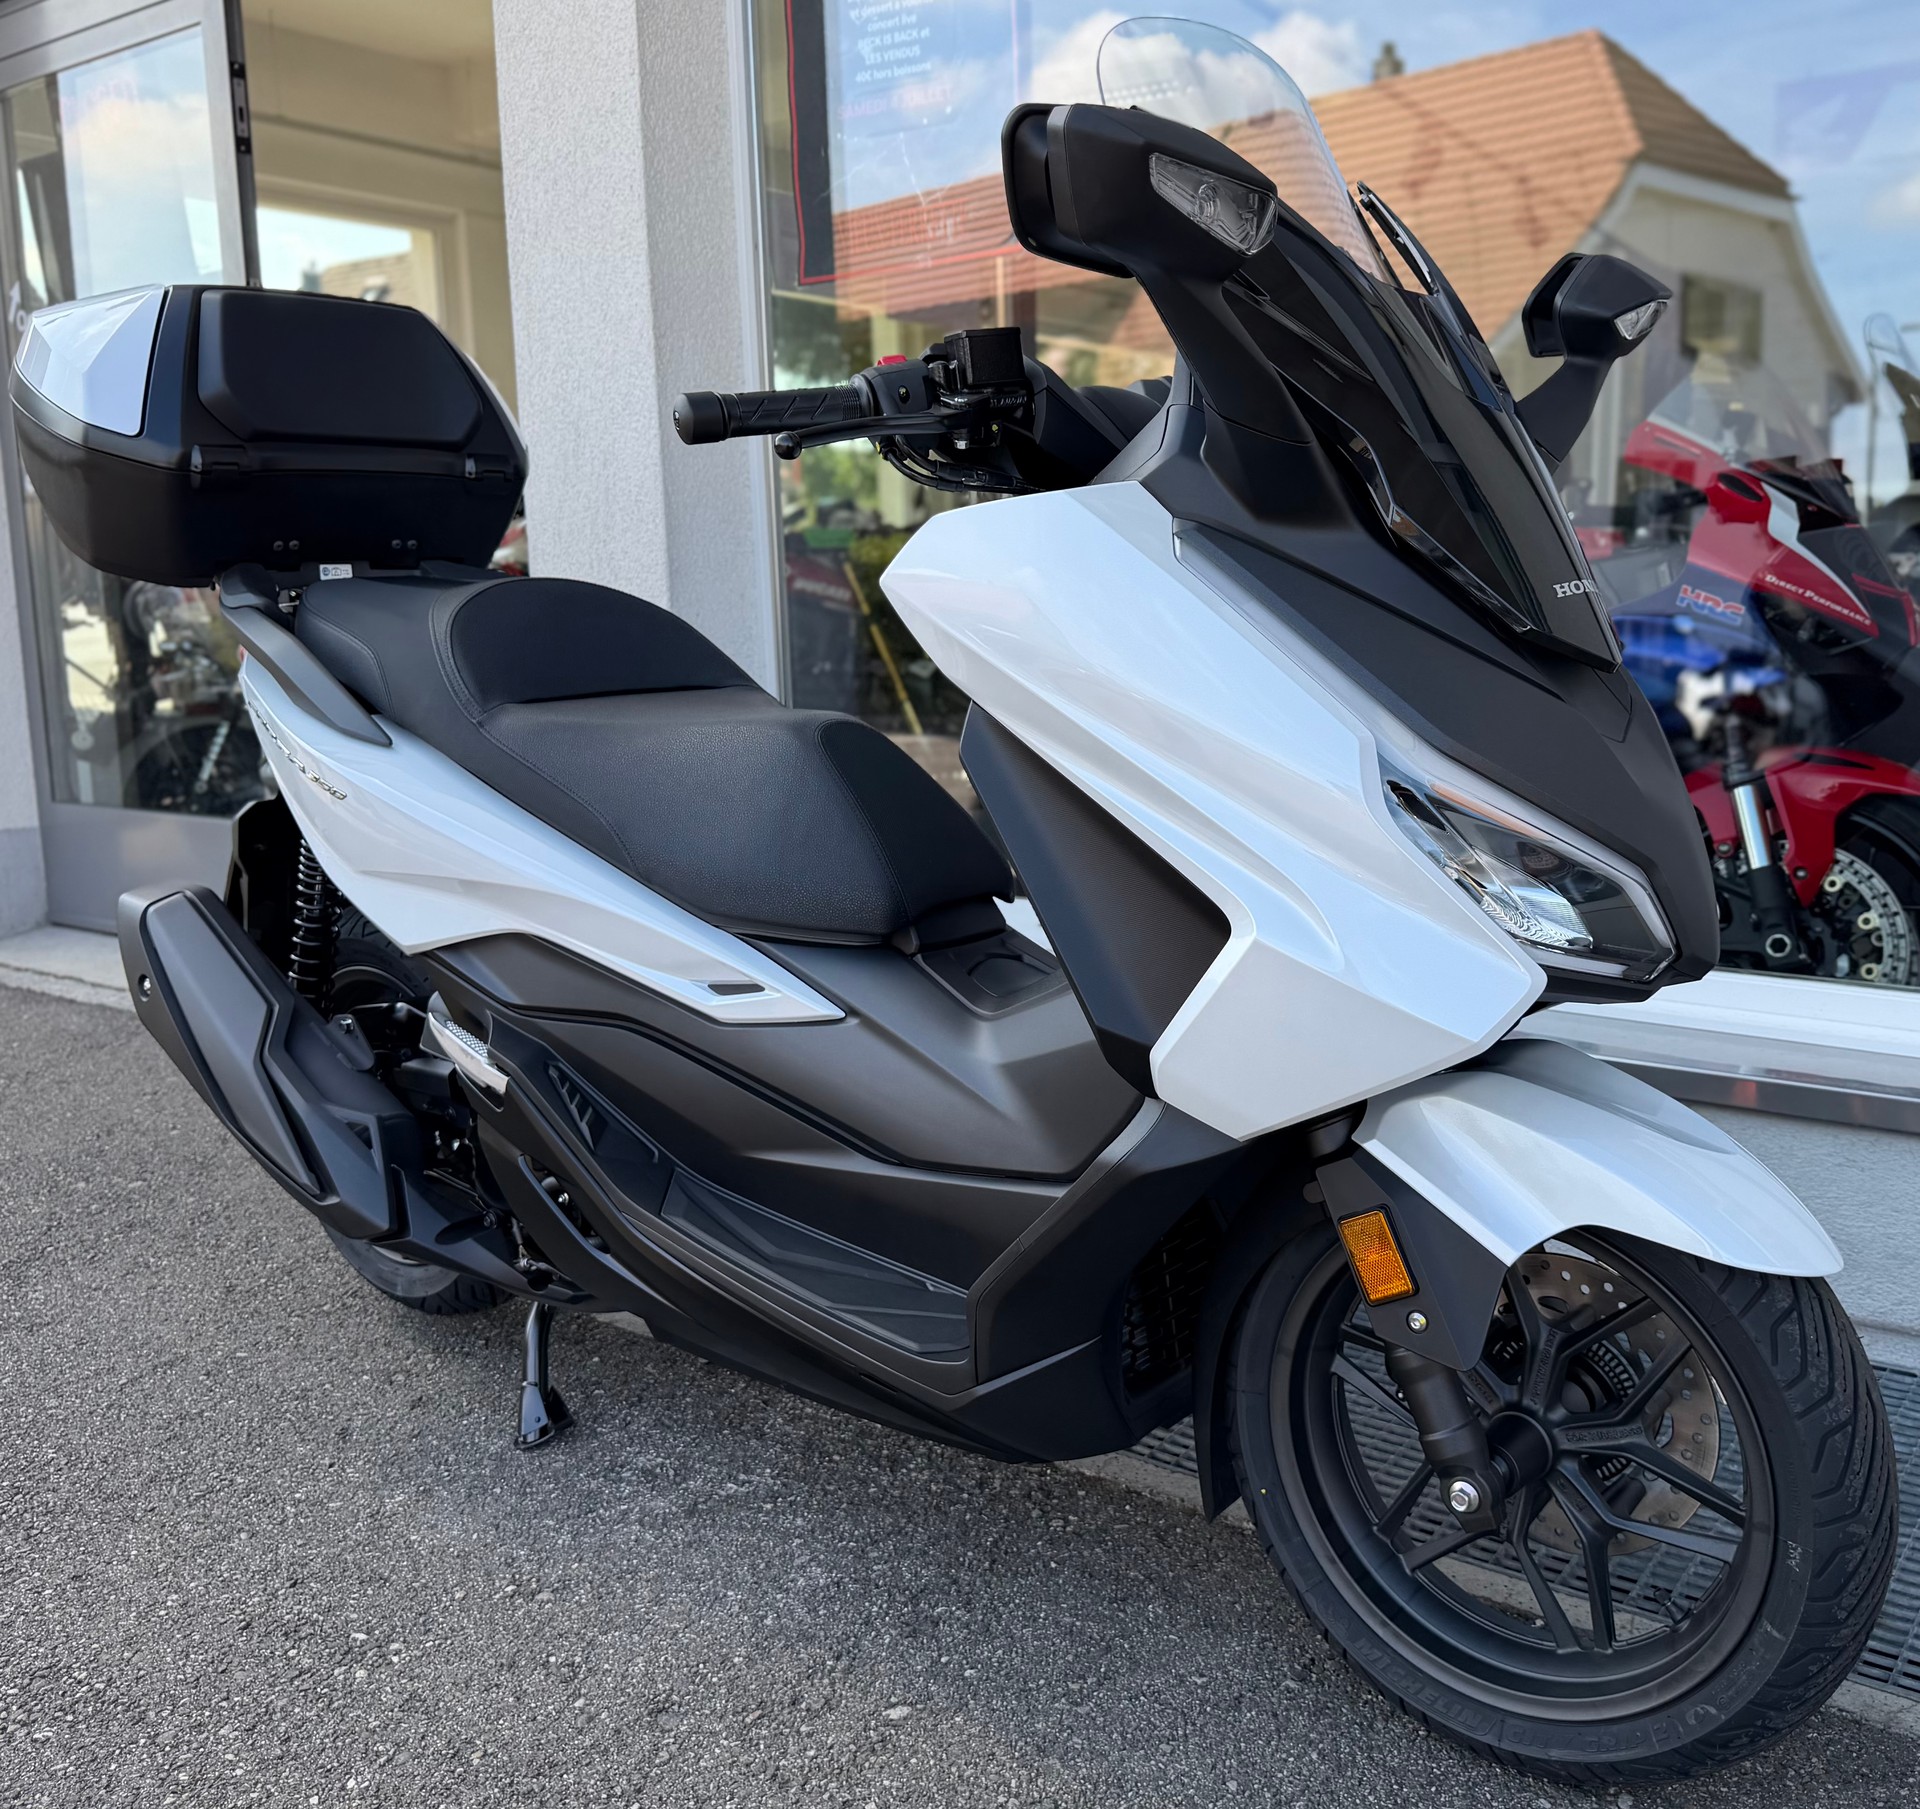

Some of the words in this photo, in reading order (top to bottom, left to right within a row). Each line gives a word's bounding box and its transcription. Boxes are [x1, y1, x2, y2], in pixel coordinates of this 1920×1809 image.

[867, 16, 899, 32] concert
[901, 13, 917, 25] live
[883, 32, 892, 45] IS
[894, 28, 918, 44] BACK
[920, 27, 931, 39] et
[865, 51, 881, 65] LES
[893, 61, 931, 77] boissons
[1676, 583, 1746, 626] HRC
[1353, 1637, 1483, 1727] MICHELIN
